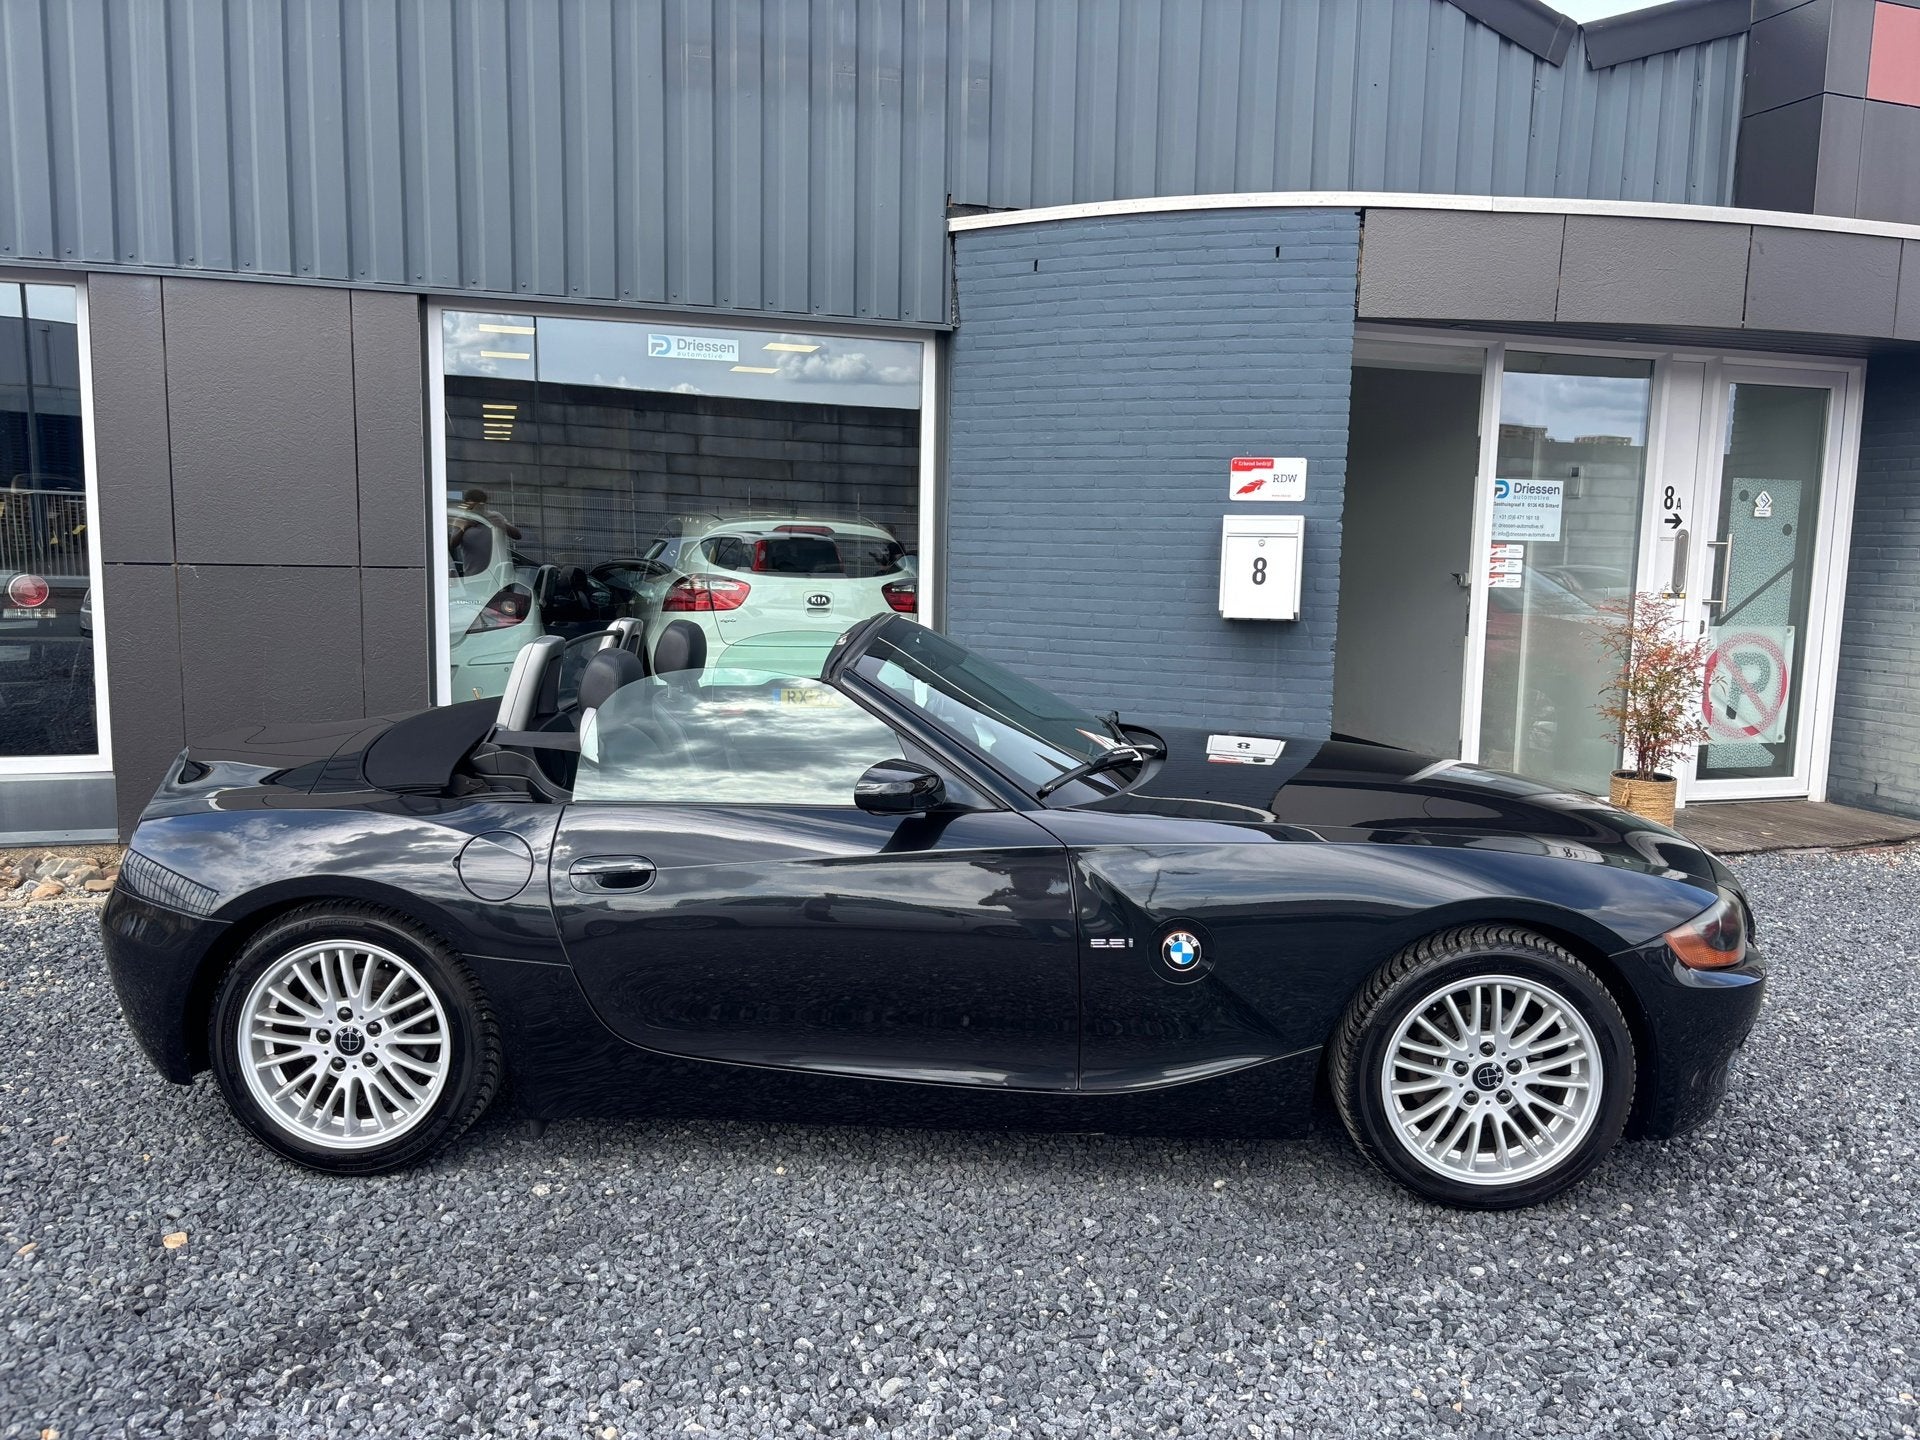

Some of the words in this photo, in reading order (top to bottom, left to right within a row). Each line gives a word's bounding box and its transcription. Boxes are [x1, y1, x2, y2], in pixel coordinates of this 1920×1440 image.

[677, 338, 736, 354] Driessen
[676, 351, 724, 360] automotive
[1272, 474, 1298, 483] RDW
[1513, 482, 1560, 495] Driessen
[1251, 556, 1268, 586] 8
[810, 596, 828, 604] KIA
[1166, 932, 1201, 948] BMW
